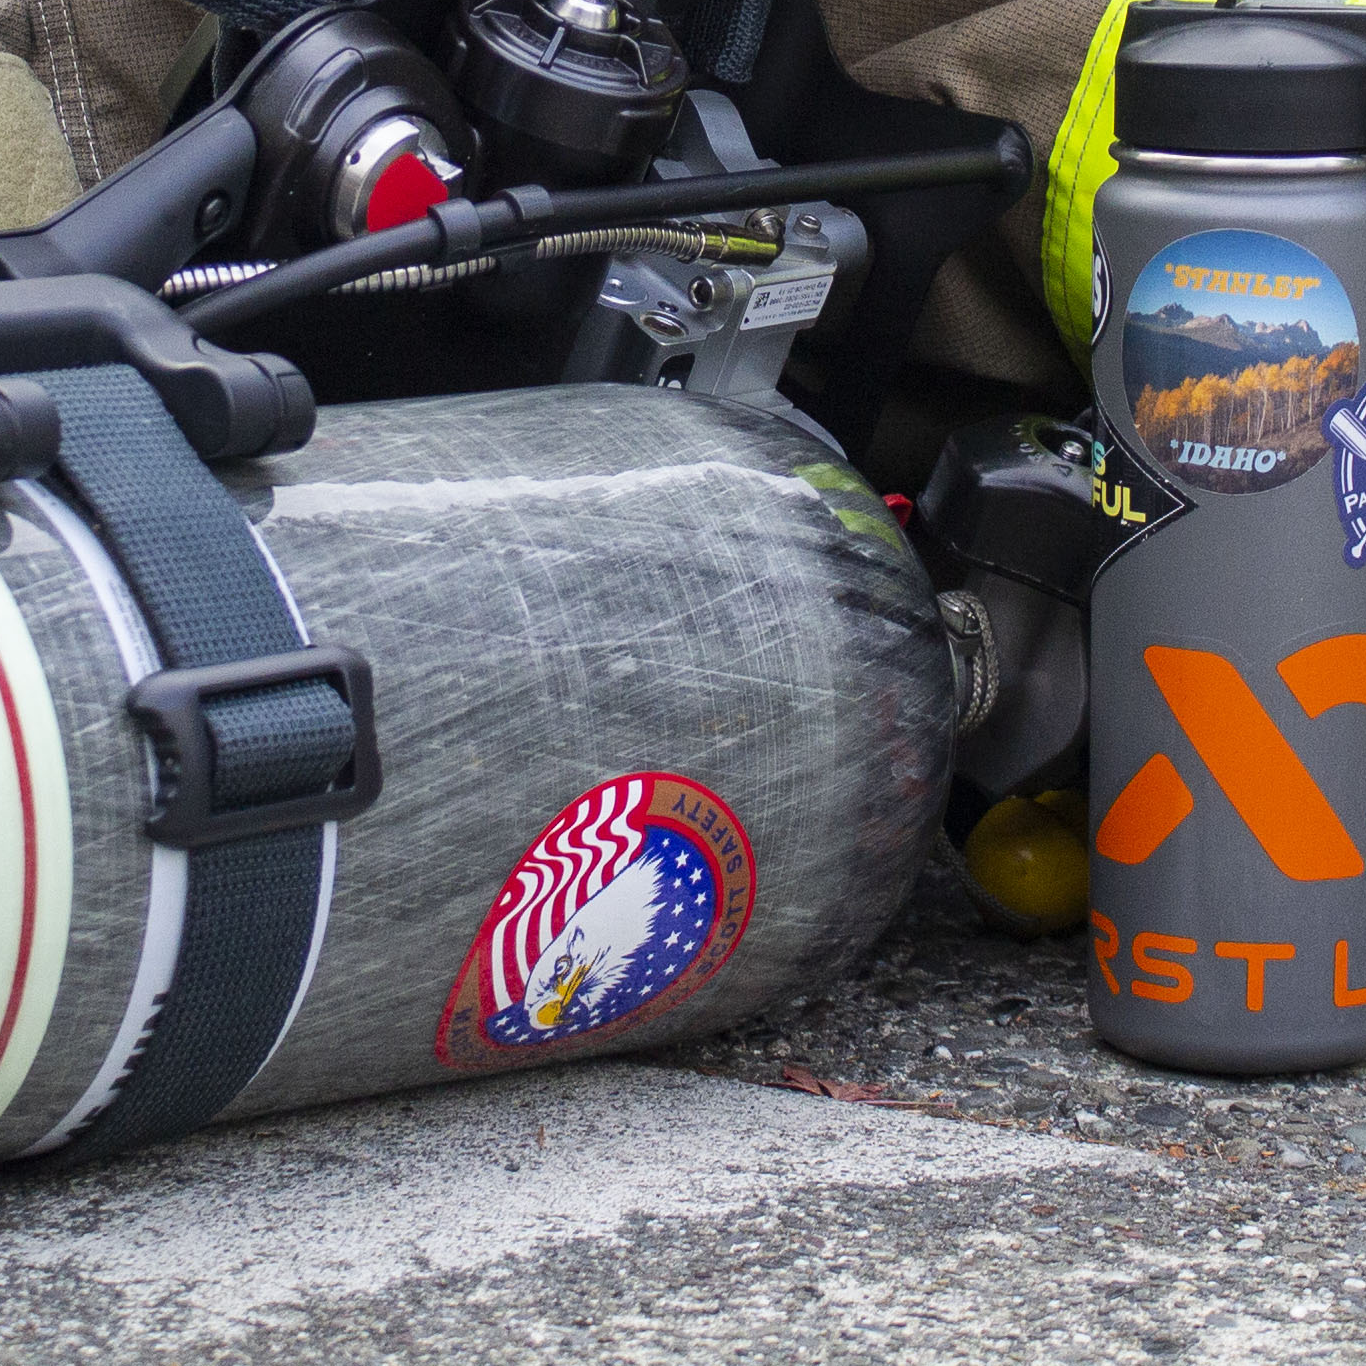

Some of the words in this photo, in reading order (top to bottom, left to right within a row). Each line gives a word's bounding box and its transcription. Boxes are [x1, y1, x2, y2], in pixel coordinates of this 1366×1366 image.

[1174, 264, 1314, 300] STANLEY
[1178, 440, 1277, 473] IDAHO
[670, 792, 744, 875] SAFETY
